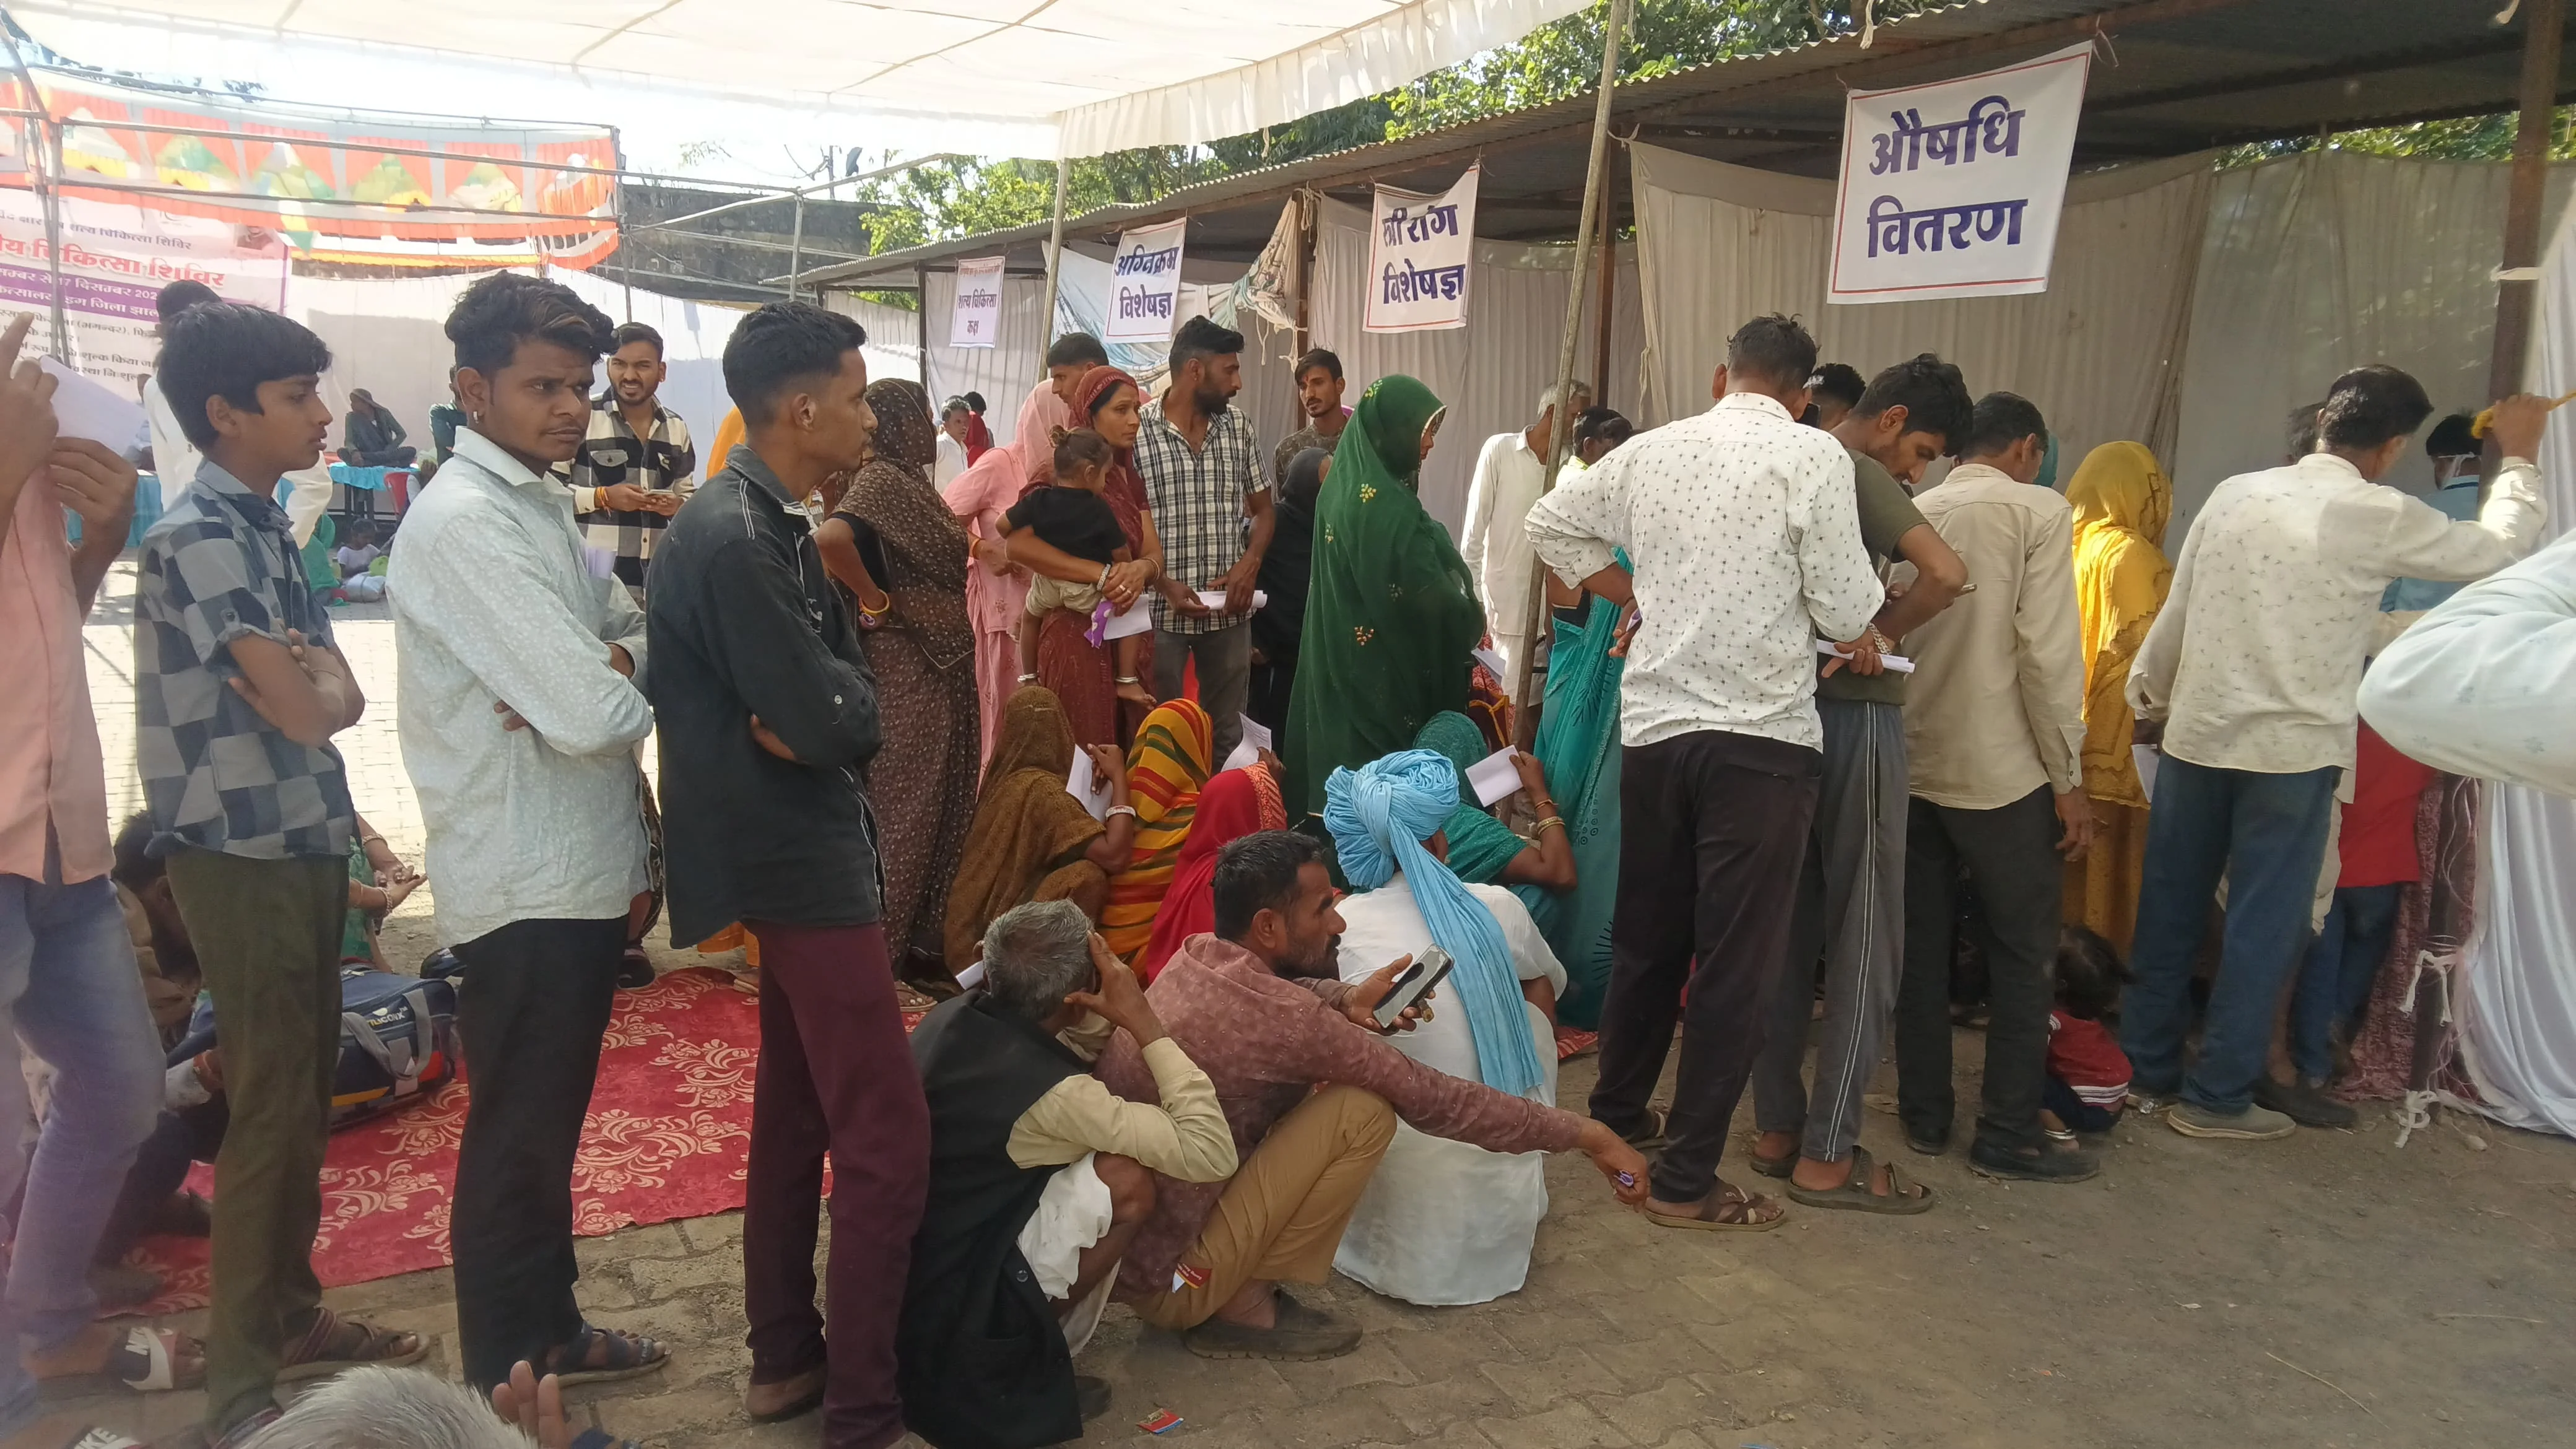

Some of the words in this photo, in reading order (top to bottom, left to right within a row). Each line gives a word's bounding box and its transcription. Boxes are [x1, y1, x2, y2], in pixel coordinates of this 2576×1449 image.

[1869, 95, 2026, 175] औषधि
[1866, 195, 2029, 258] वितरण
[156, 235, 192, 250] शिविर
[135, 289, 158, 301] 202
[1383, 258, 1466, 305] विशेषज्ञ
[958, 294, 972, 309] शल्य
[972, 288, 998, 308] चिकित्सा
[1119, 284, 1173, 320] विशेषज्ञ
[967, 320, 980, 336] कक्ष
